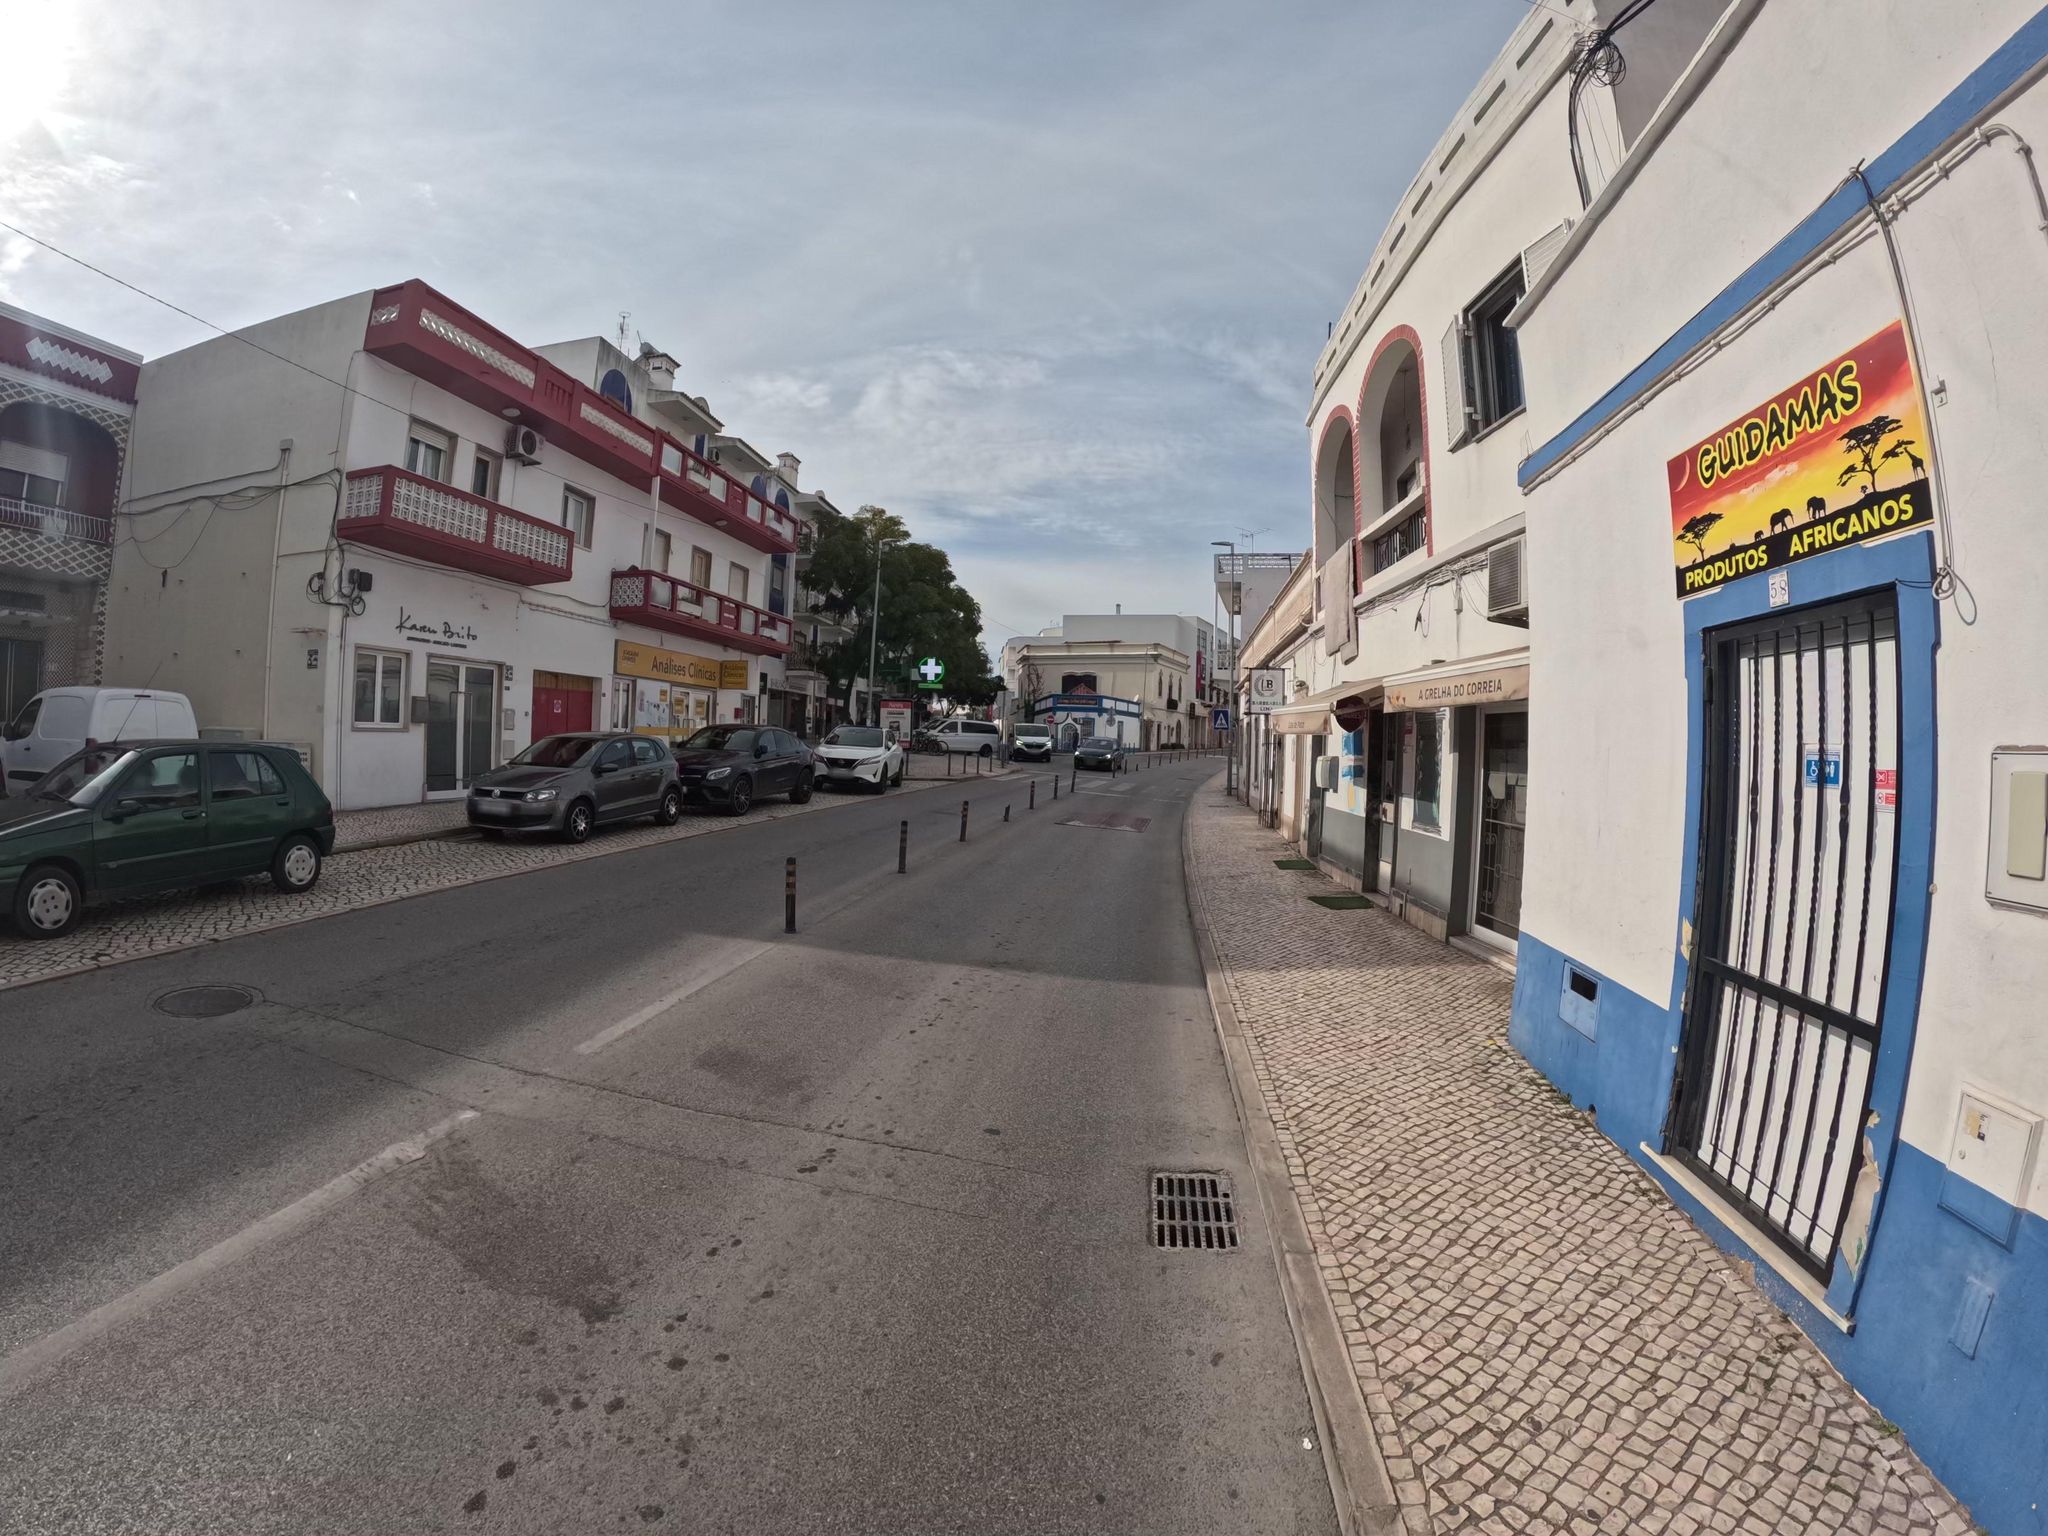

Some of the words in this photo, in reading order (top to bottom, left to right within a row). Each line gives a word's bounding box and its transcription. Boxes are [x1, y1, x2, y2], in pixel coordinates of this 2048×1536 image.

[1698, 361, 1861, 487] GUIDAMAS
[1686, 545, 1768, 590] PRODUTOS
[1789, 494, 1914, 557] AFRICANOS
[1770, 579, 1787, 599] 58
[396, 606, 438, 634] Karen
[443, 621, 478, 640] Brito
[651, 656, 686, 677] Análises
[688, 662, 717, 682] Clínicas
[1418, 690, 1423, 700] A
[1424, 685, 1452, 699] GRELHA
[1453, 684, 1464, 696] DO
[1466, 679, 1502, 695] CORREIA
